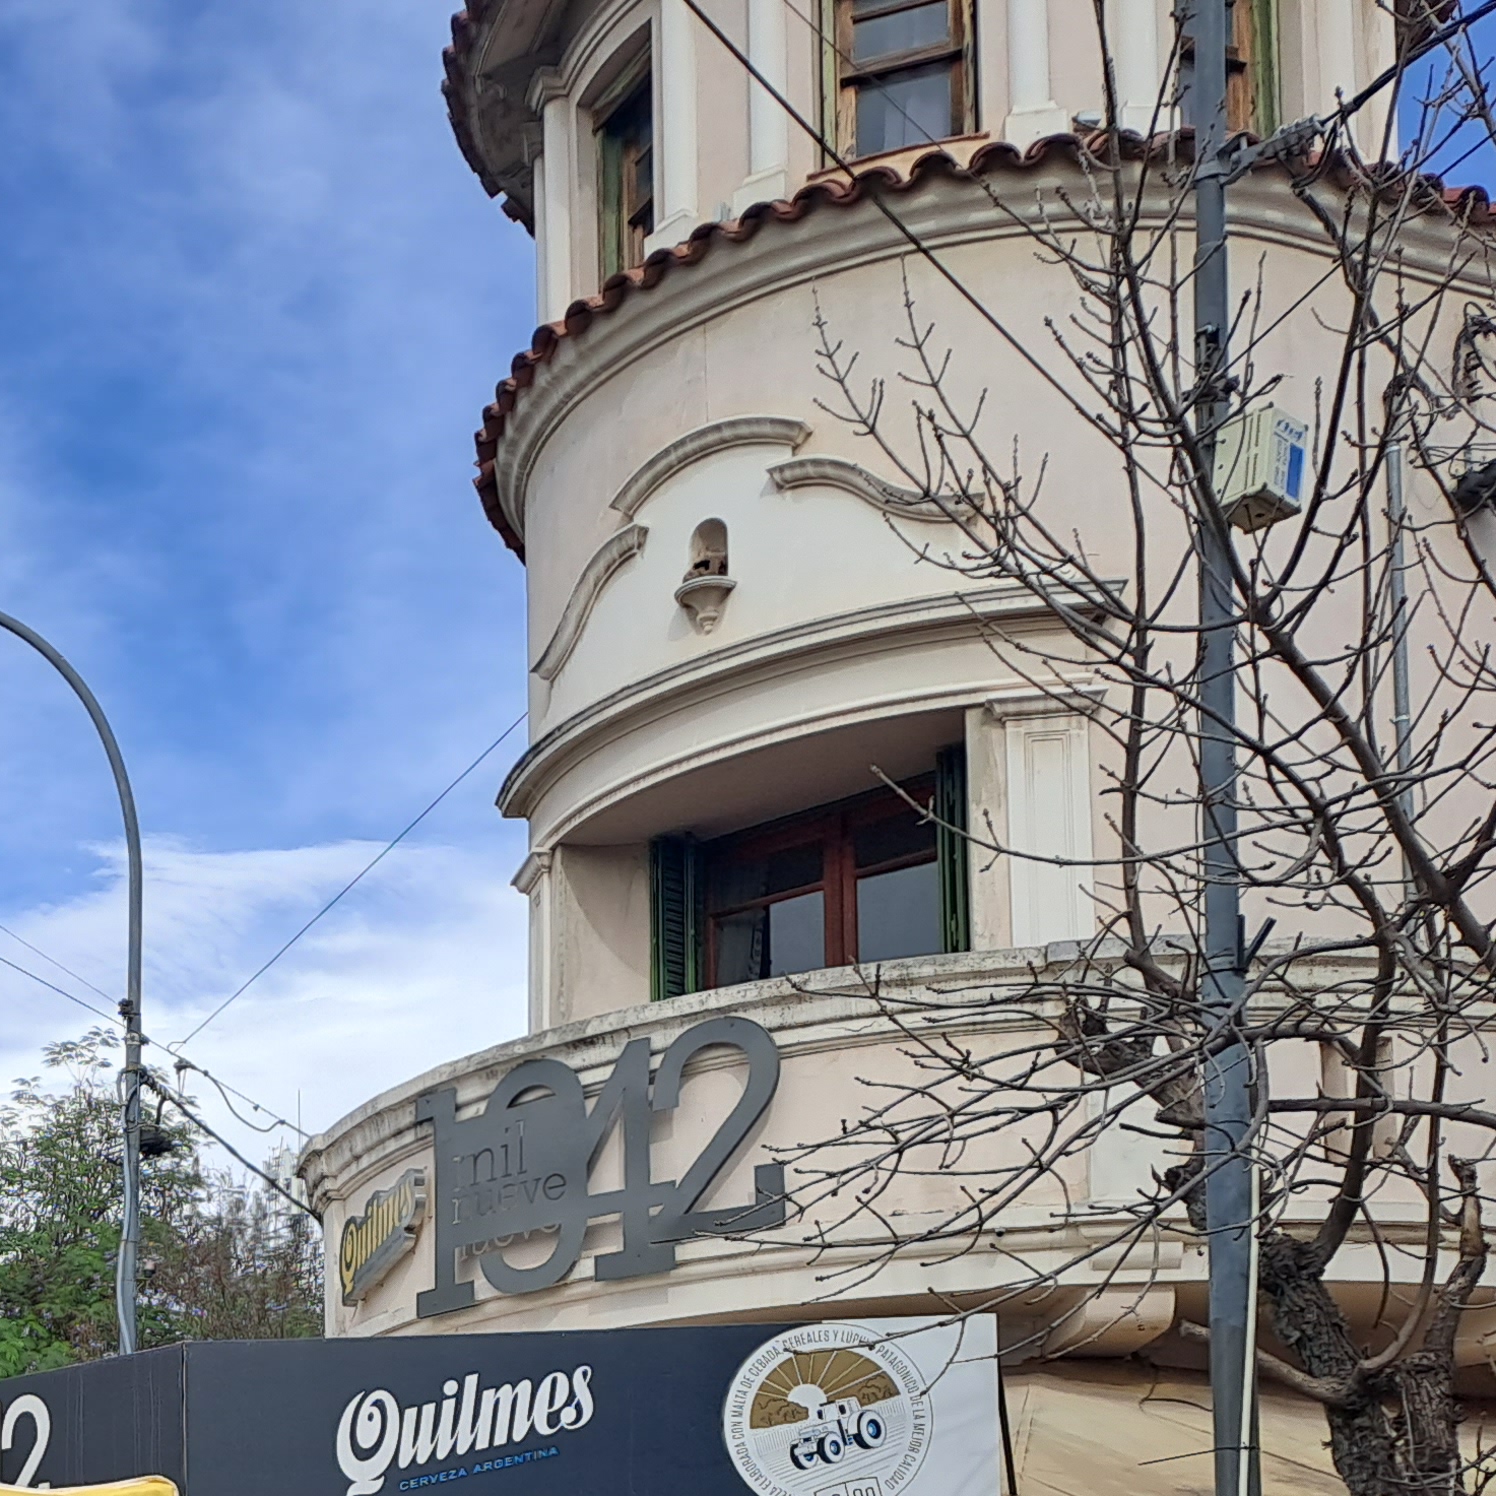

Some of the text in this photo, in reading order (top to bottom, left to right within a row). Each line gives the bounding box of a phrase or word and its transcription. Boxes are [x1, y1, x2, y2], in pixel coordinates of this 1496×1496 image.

[416, 1015, 785, 1318] 1942
[782, 1329, 830, 1350] CEREALES
[833, 1330, 839, 1342] Y
[740, 1374, 756, 1389] DE
[730, 1389, 748, 1418] MALTA
[912, 1409, 926, 1420] LA
[730, 1421, 744, 1440] CON
[908, 1423, 926, 1454] MEJOR
[399, 1446, 559, 1491] CERVEZA ARGENTINA
[733, 1441, 772, 1491] ELABORADA
[884, 1453, 916, 1491] CALIDAD
